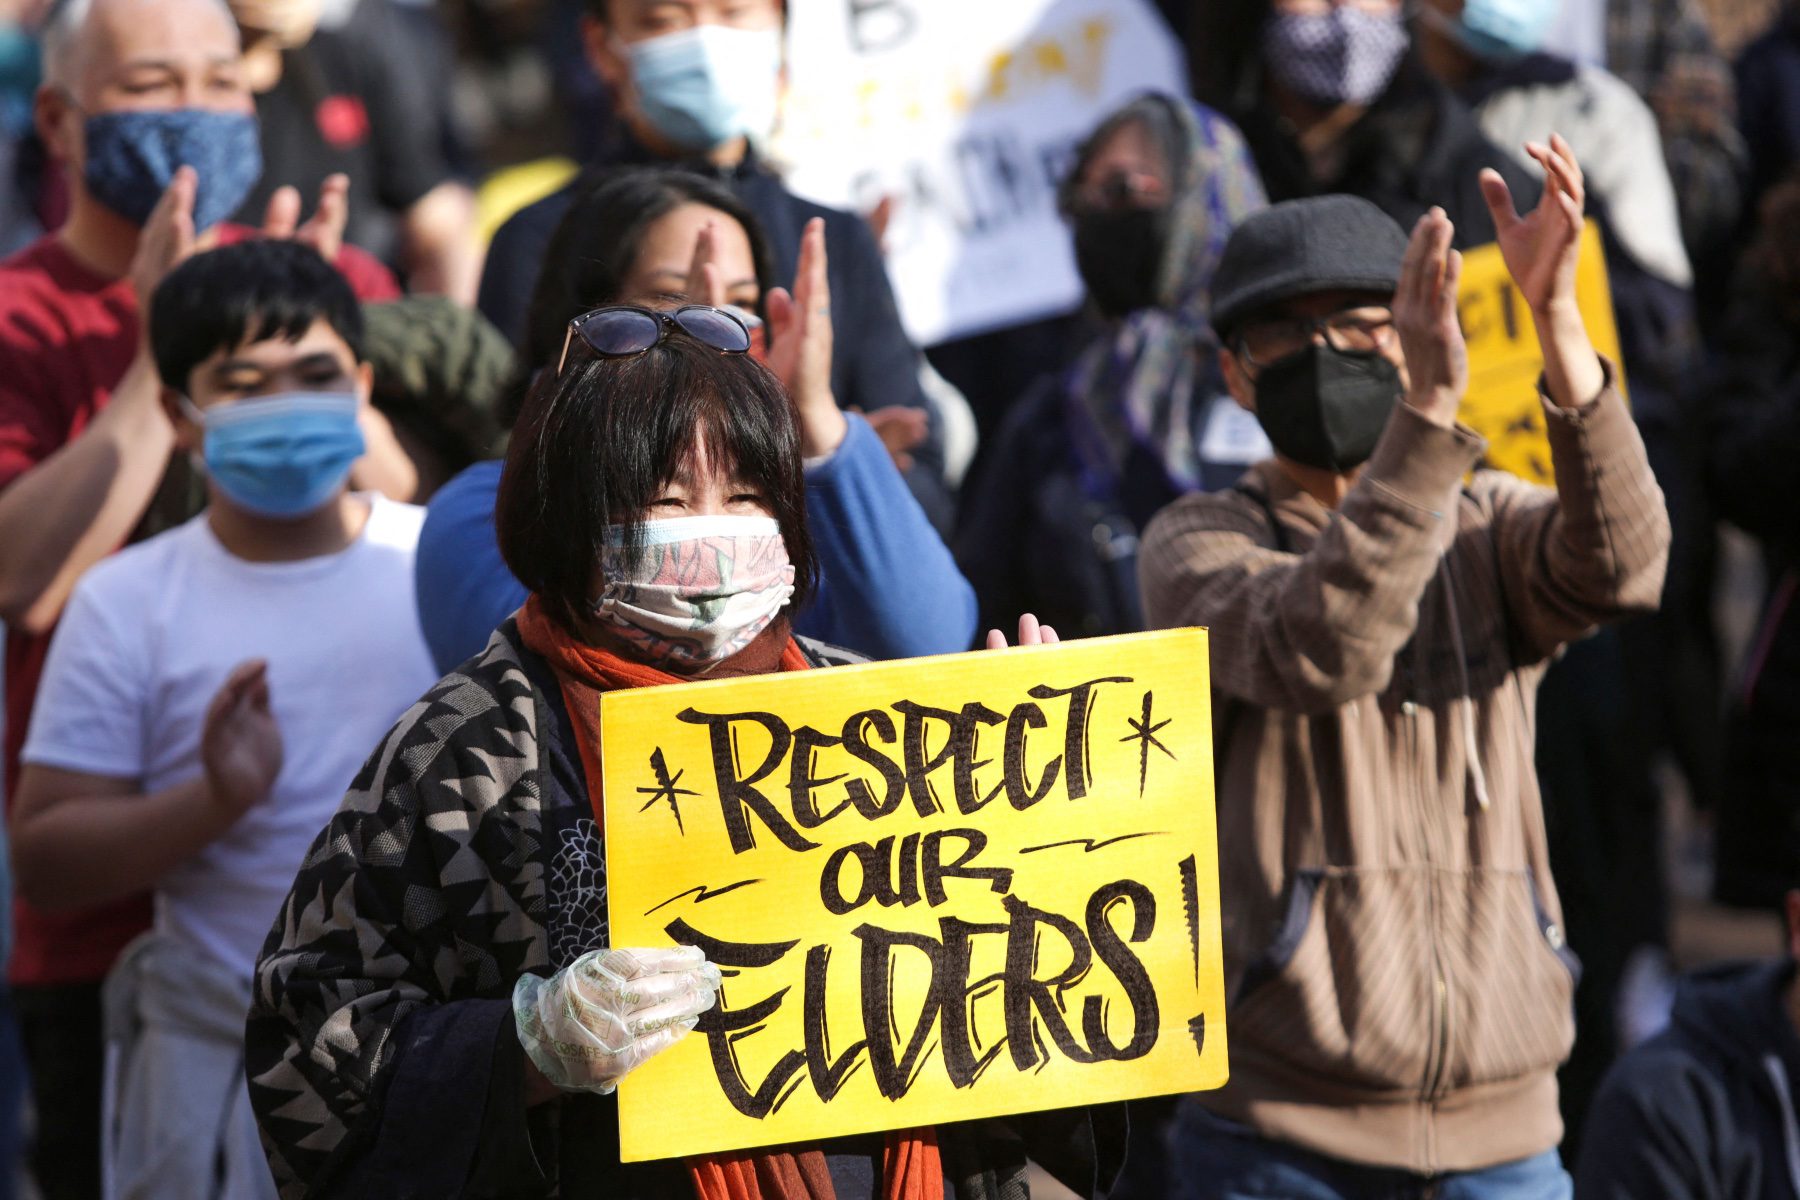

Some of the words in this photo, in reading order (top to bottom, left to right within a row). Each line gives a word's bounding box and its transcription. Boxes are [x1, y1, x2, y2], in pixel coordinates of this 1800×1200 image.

[676, 676, 1134, 855] RESPECT
[819, 827, 1014, 916] OUR
[664, 853, 1206, 1121] ELDERS!
